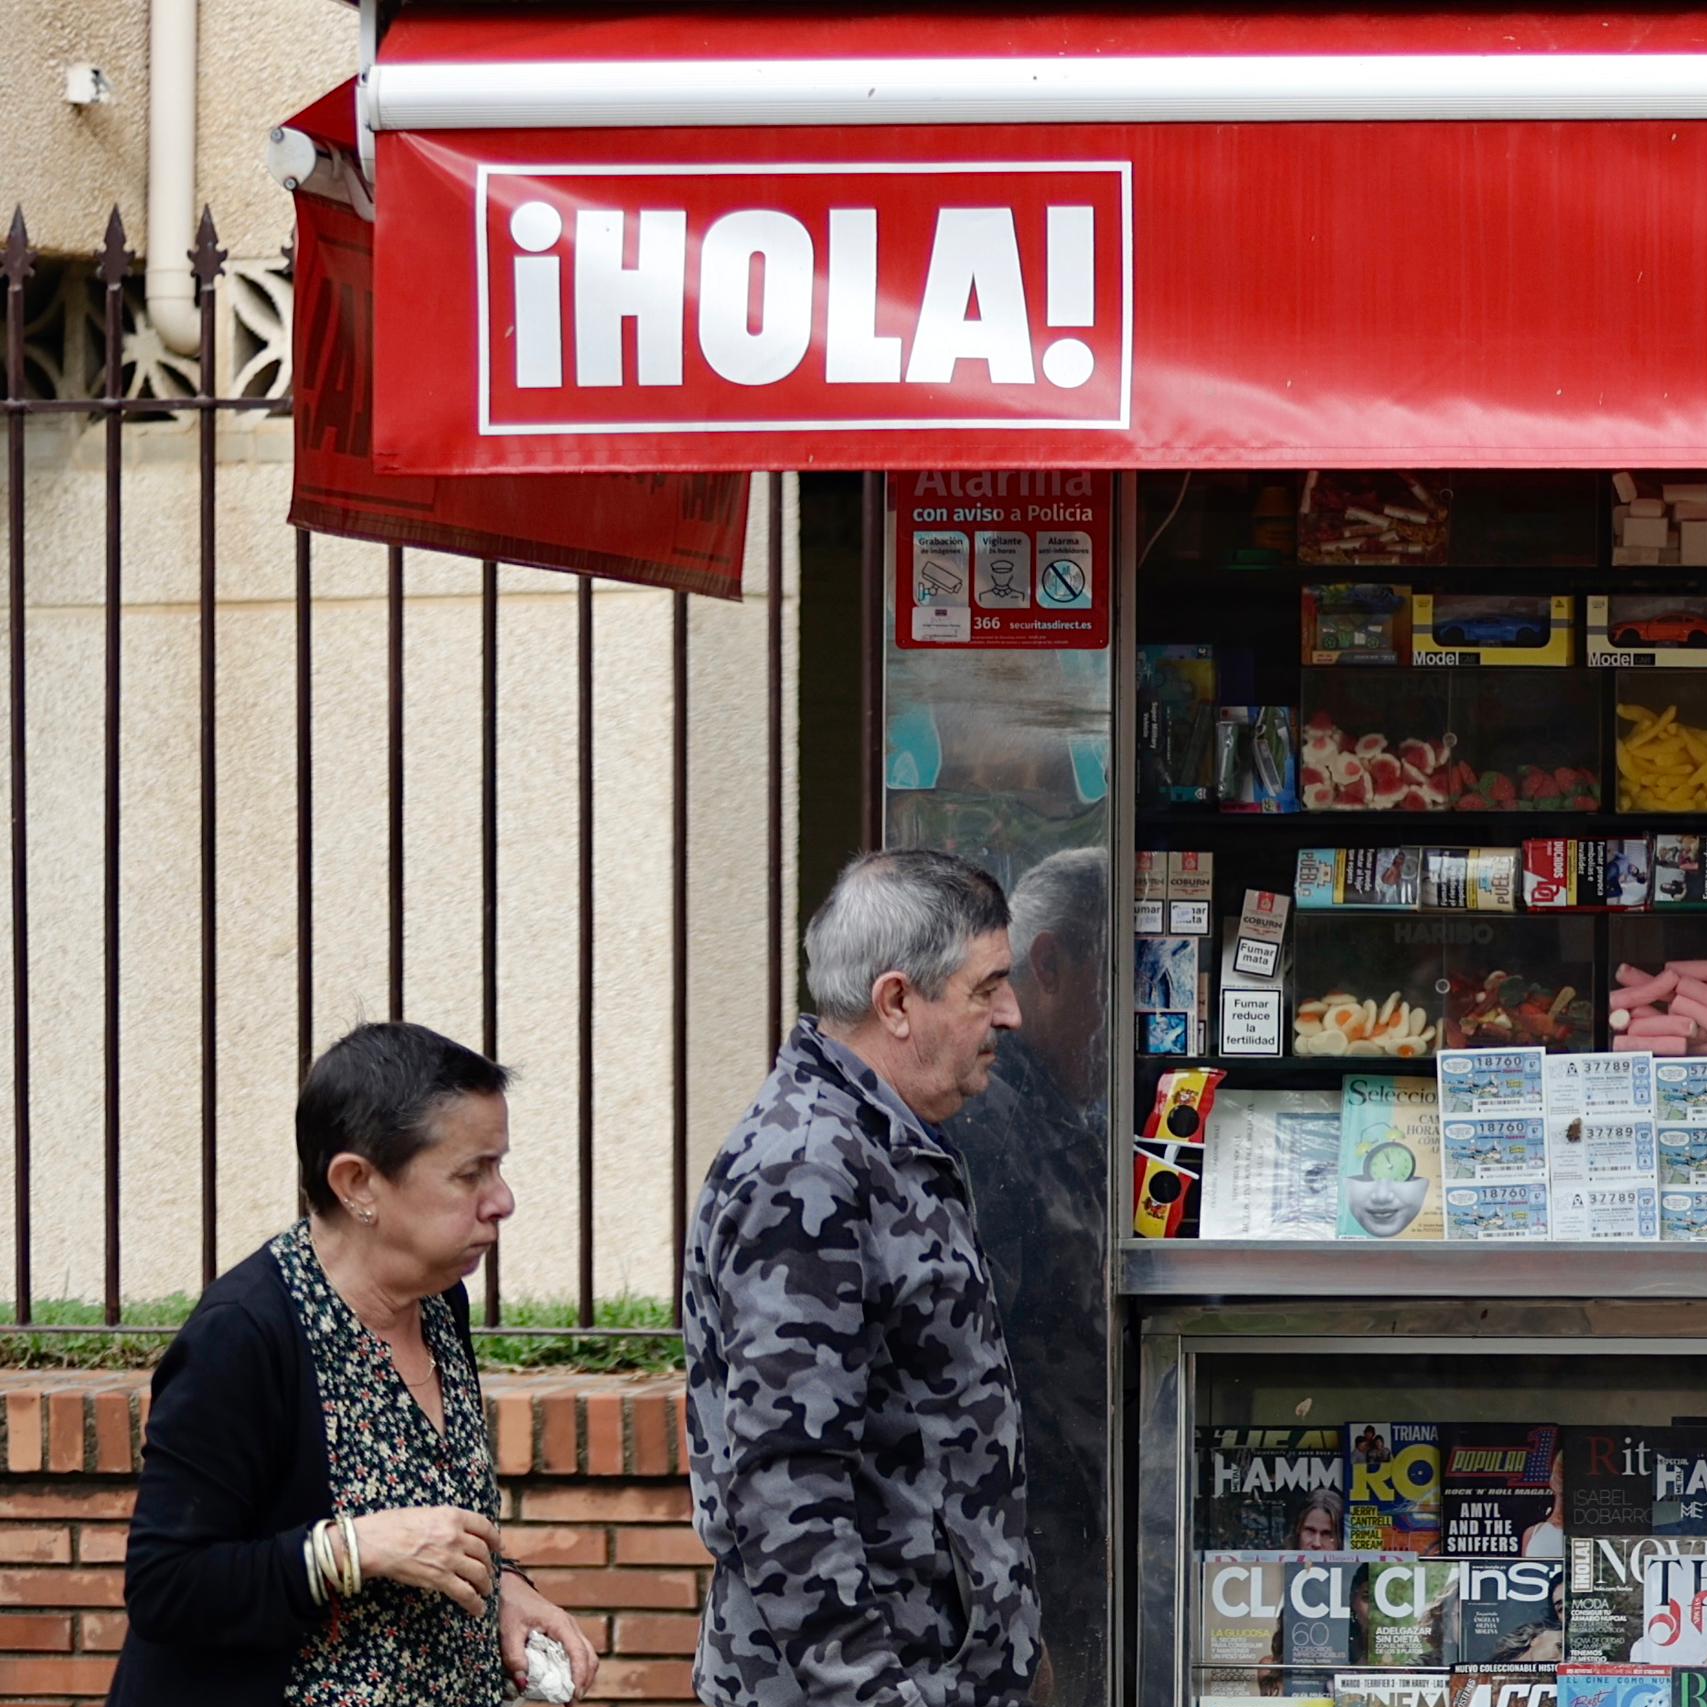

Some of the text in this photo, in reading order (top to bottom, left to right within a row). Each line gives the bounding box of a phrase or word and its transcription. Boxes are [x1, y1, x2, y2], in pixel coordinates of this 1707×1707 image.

[510, 201, 1095, 389] ¡HOLA!
[914, 471, 1093, 497] Alarma
[913, 503, 1092, 522] con aviso a Policía
[918, 537, 963, 546] Grabación
[983, 536, 1022, 547] Vigilante
[1048, 537, 1079, 545] Alarma
[974, 617, 1092, 630] 366 securitasdirect.es
[1412, 650, 1459, 666] Model
[1587, 651, 1634, 667] Model
[1243, 916, 1283, 929] COBURN
[1241, 943, 1274, 957] Fumar
[1243, 954, 1269, 965] mata
[1234, 999, 1269, 1009] Fumar
[1232, 1011, 1270, 1020] reduce
[1246, 1023, 1256, 1033] la
[1226, 1035, 1275, 1046] fertilidad
[1477, 1056, 1522, 1067] 18760
[1583, 1061, 1631, 1073] 37789
[1348, 1079, 1437, 1106] Seleccio
[1479, 1122, 1525, 1133] 18760
[1586, 1127, 1633, 1138] 37789
[1482, 1188, 1527, 1199] 18760
[1589, 1192, 1636, 1204] 37789
[1392, 1425, 1439, 1441] TRIANA
[1450, 1451, 1528, 1473] POPULAR
[1572, 1489, 1632, 1507] ISABEL
[1350, 1506, 1378, 1517] JERRY
[1460, 1502, 1501, 1518] AMYL
[1350, 1516, 1392, 1527] CANTRELL
[1449, 1519, 1512, 1536] AND THE
[1350, 1530, 1381, 1540] PRIMAL
[1350, 1540, 1383, 1550] SCREAM
[1447, 1536, 1519, 1553] SNIFFERS
[1572, 1599, 1609, 1609] MODA
[1292, 1622, 1329, 1646] 60
[1376, 1627, 1432, 1635] ADELGAZAR
[1376, 1635, 1420, 1643] SIN DIETA
[1455, 1663, 1537, 1673] NUEVO COLECCIONABLE
